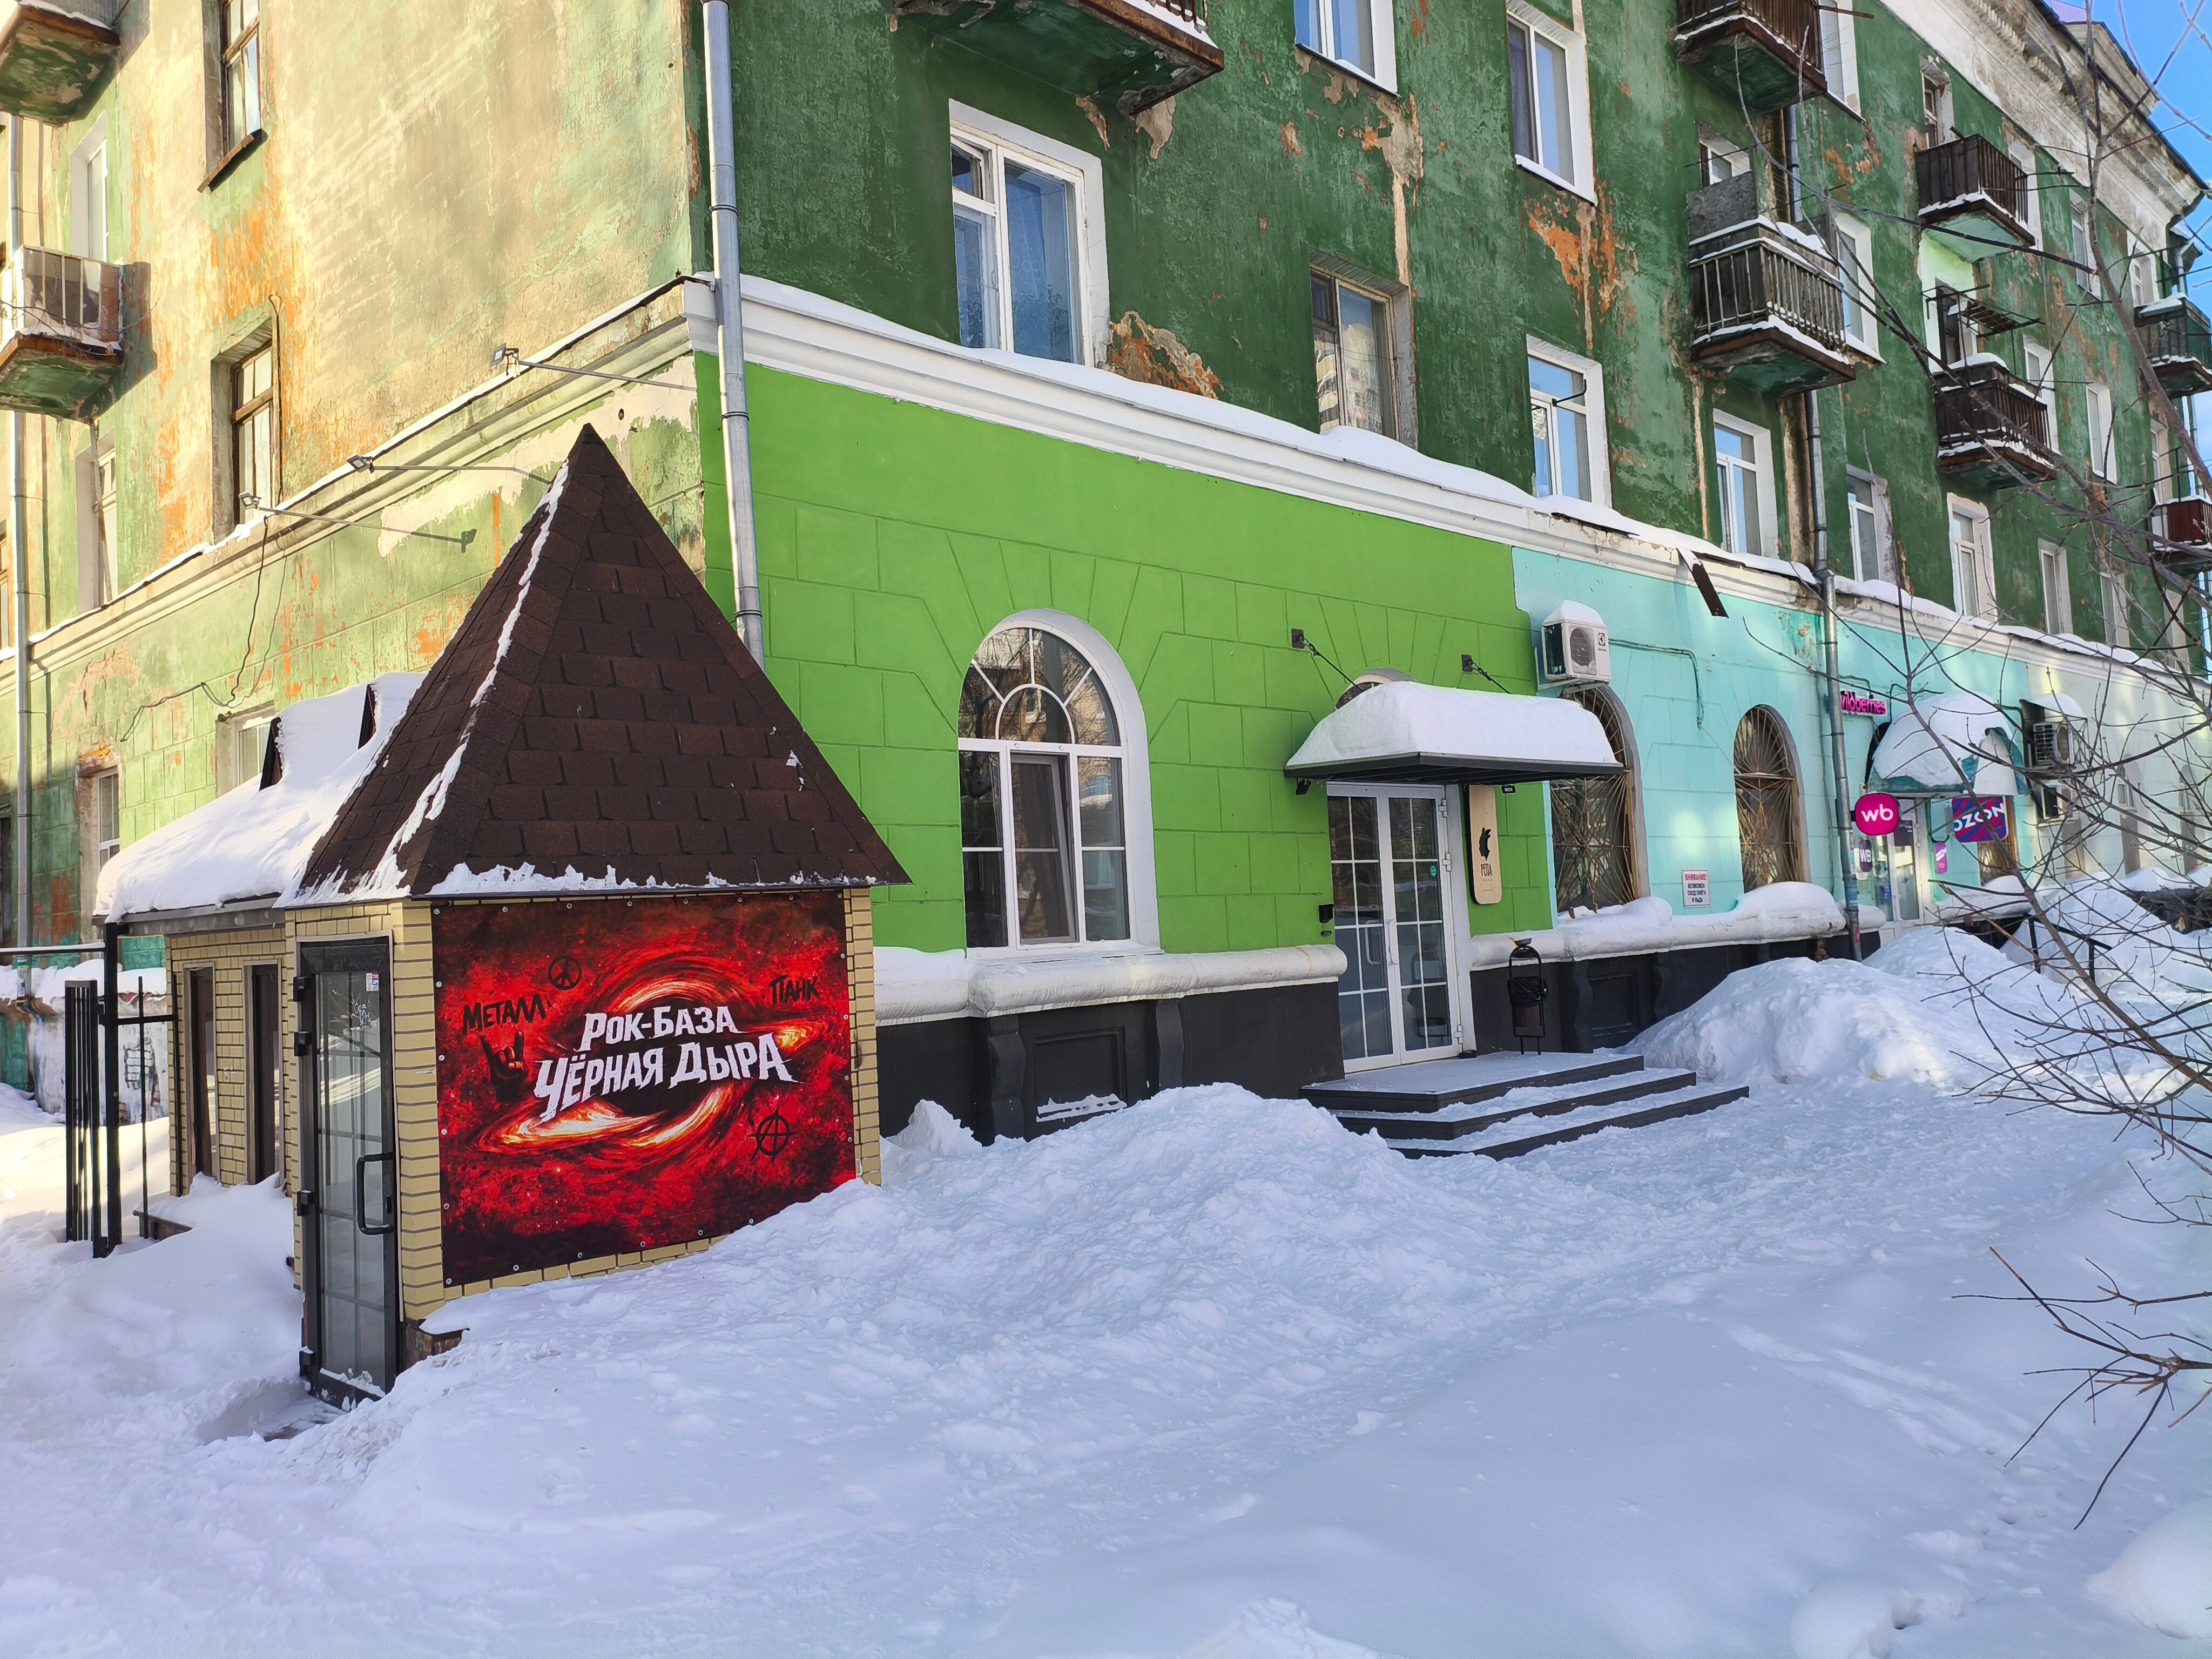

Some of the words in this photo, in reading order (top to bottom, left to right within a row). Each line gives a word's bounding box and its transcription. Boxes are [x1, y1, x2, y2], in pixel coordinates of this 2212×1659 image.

[1861, 804, 1893, 822] wb
[1953, 803, 2005, 832] OZON
[1860, 849, 1872, 862] WB
[769, 974, 820, 1007] ПАНК
[463, 994, 546, 1037] МЕТАЛЛ
[534, 1047, 664, 1123] ЧЁРНАЯ
[669, 1032, 806, 1090] ДЫРА
